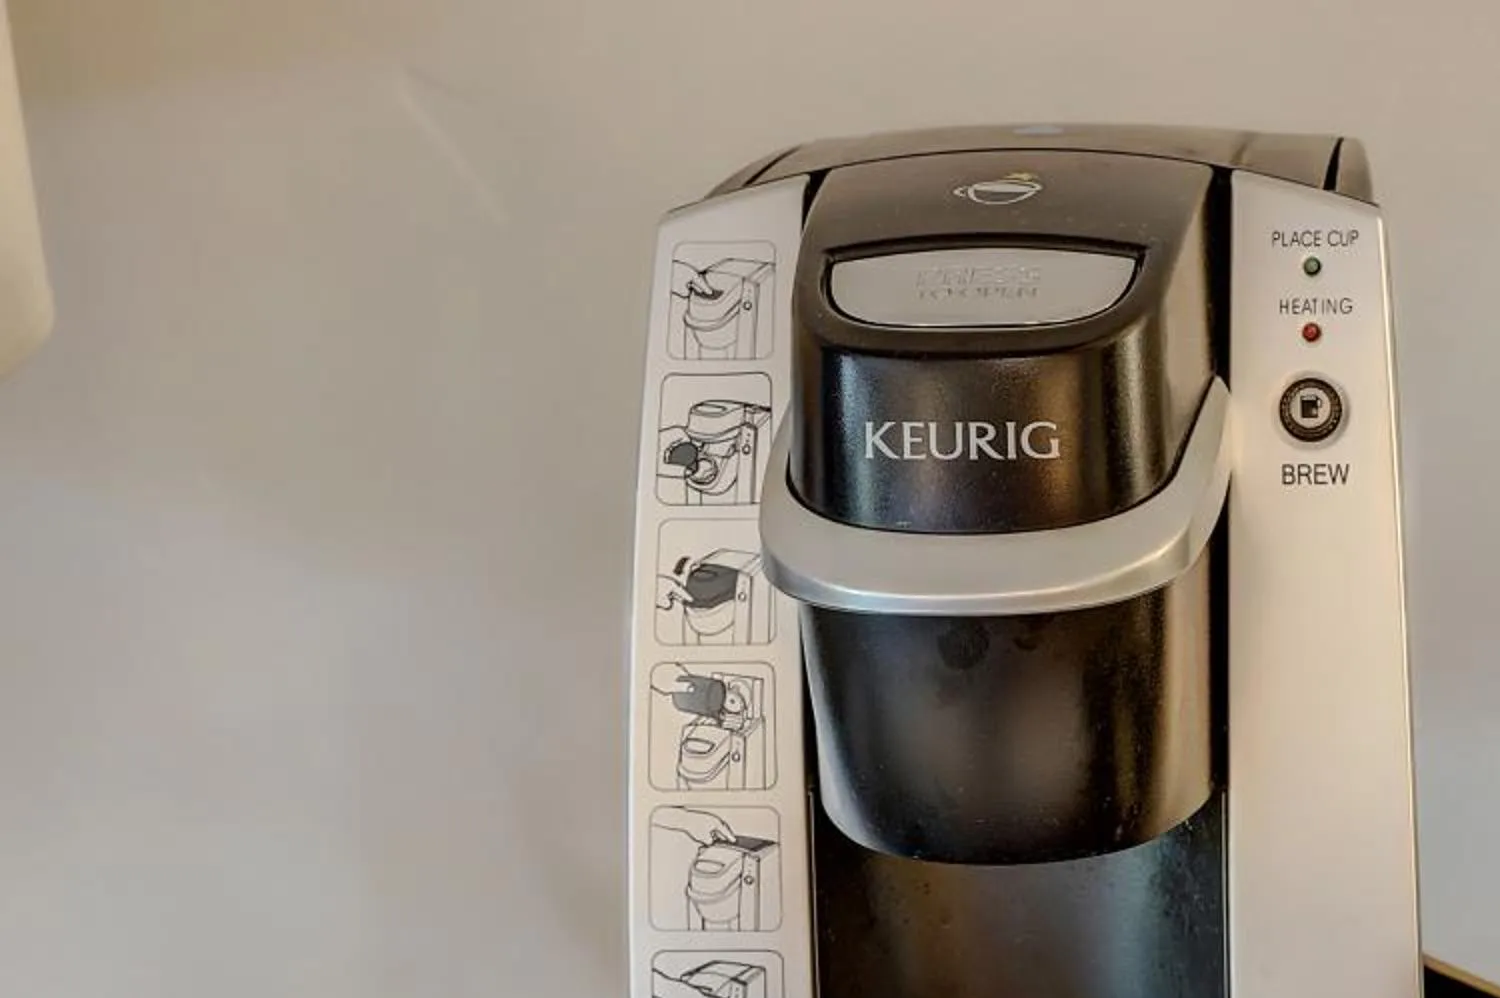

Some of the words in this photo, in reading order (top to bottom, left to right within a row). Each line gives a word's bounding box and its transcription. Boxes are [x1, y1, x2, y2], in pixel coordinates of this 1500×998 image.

[1271, 230, 1322, 248] PLACE
[1327, 229, 1360, 247] CUP
[1279, 298, 1353, 315] HEATING
[864, 420, 1061, 460] KEURIG
[1281, 463, 1350, 485] BREW
